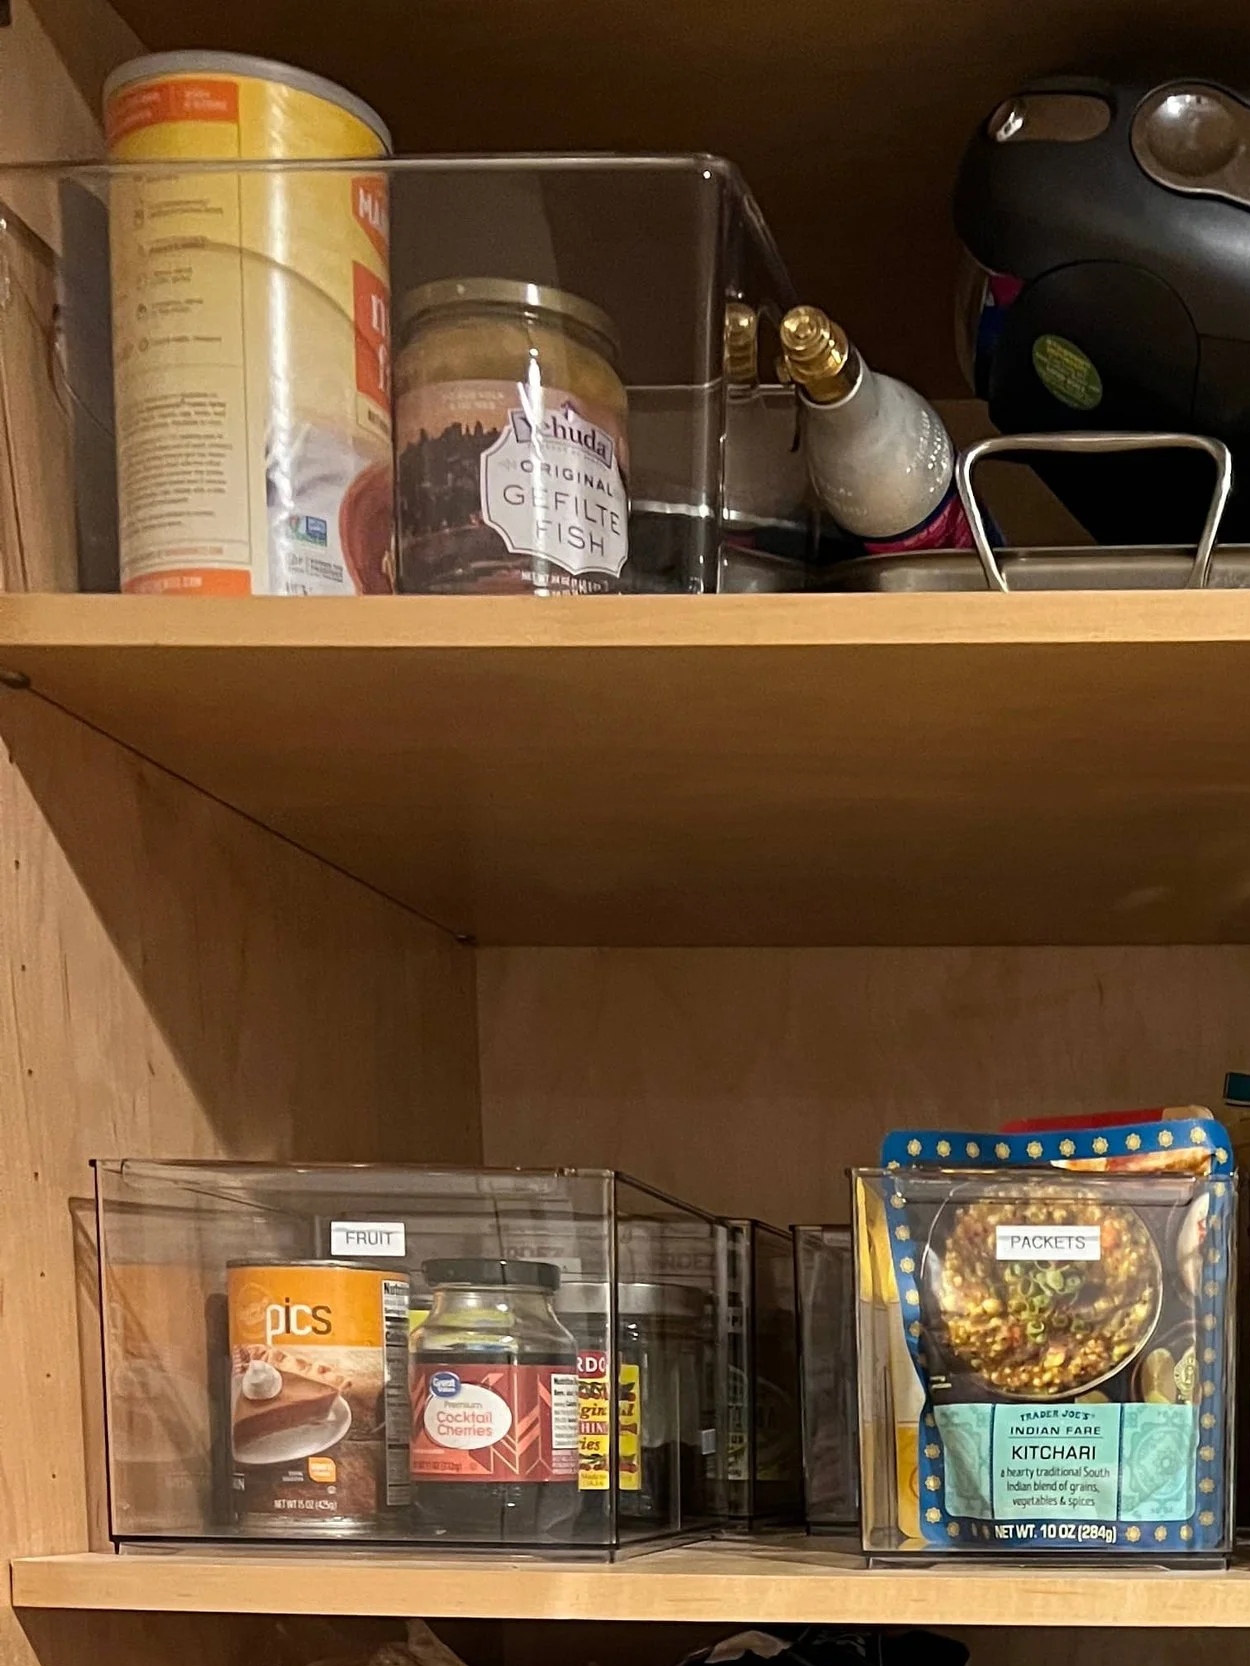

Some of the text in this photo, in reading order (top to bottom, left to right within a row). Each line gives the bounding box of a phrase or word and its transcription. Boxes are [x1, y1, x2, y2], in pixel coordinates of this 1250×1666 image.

[520, 460, 614, 497] ORIGINAL
[503, 485, 621, 535] GEFILTE
[536, 520, 604, 556] FISH
[345, 1231, 393, 1246] FRUIT
[1010, 1236, 1086, 1249] PACKETS
[265, 1297, 332, 1346] pics
[444, 1400, 483, 1409] Premium
[436, 1410, 493, 1425] Cocktail
[437, 1424, 493, 1437] Cherries
[1010, 1426, 1101, 1436] INDIAN FARE
[1011, 1445, 1096, 1460] KITCHARI
[1012, 1496, 1095, 1508] vegetables & spices
[995, 1525, 1117, 1543] NET WT. 10 OZ (284g)
